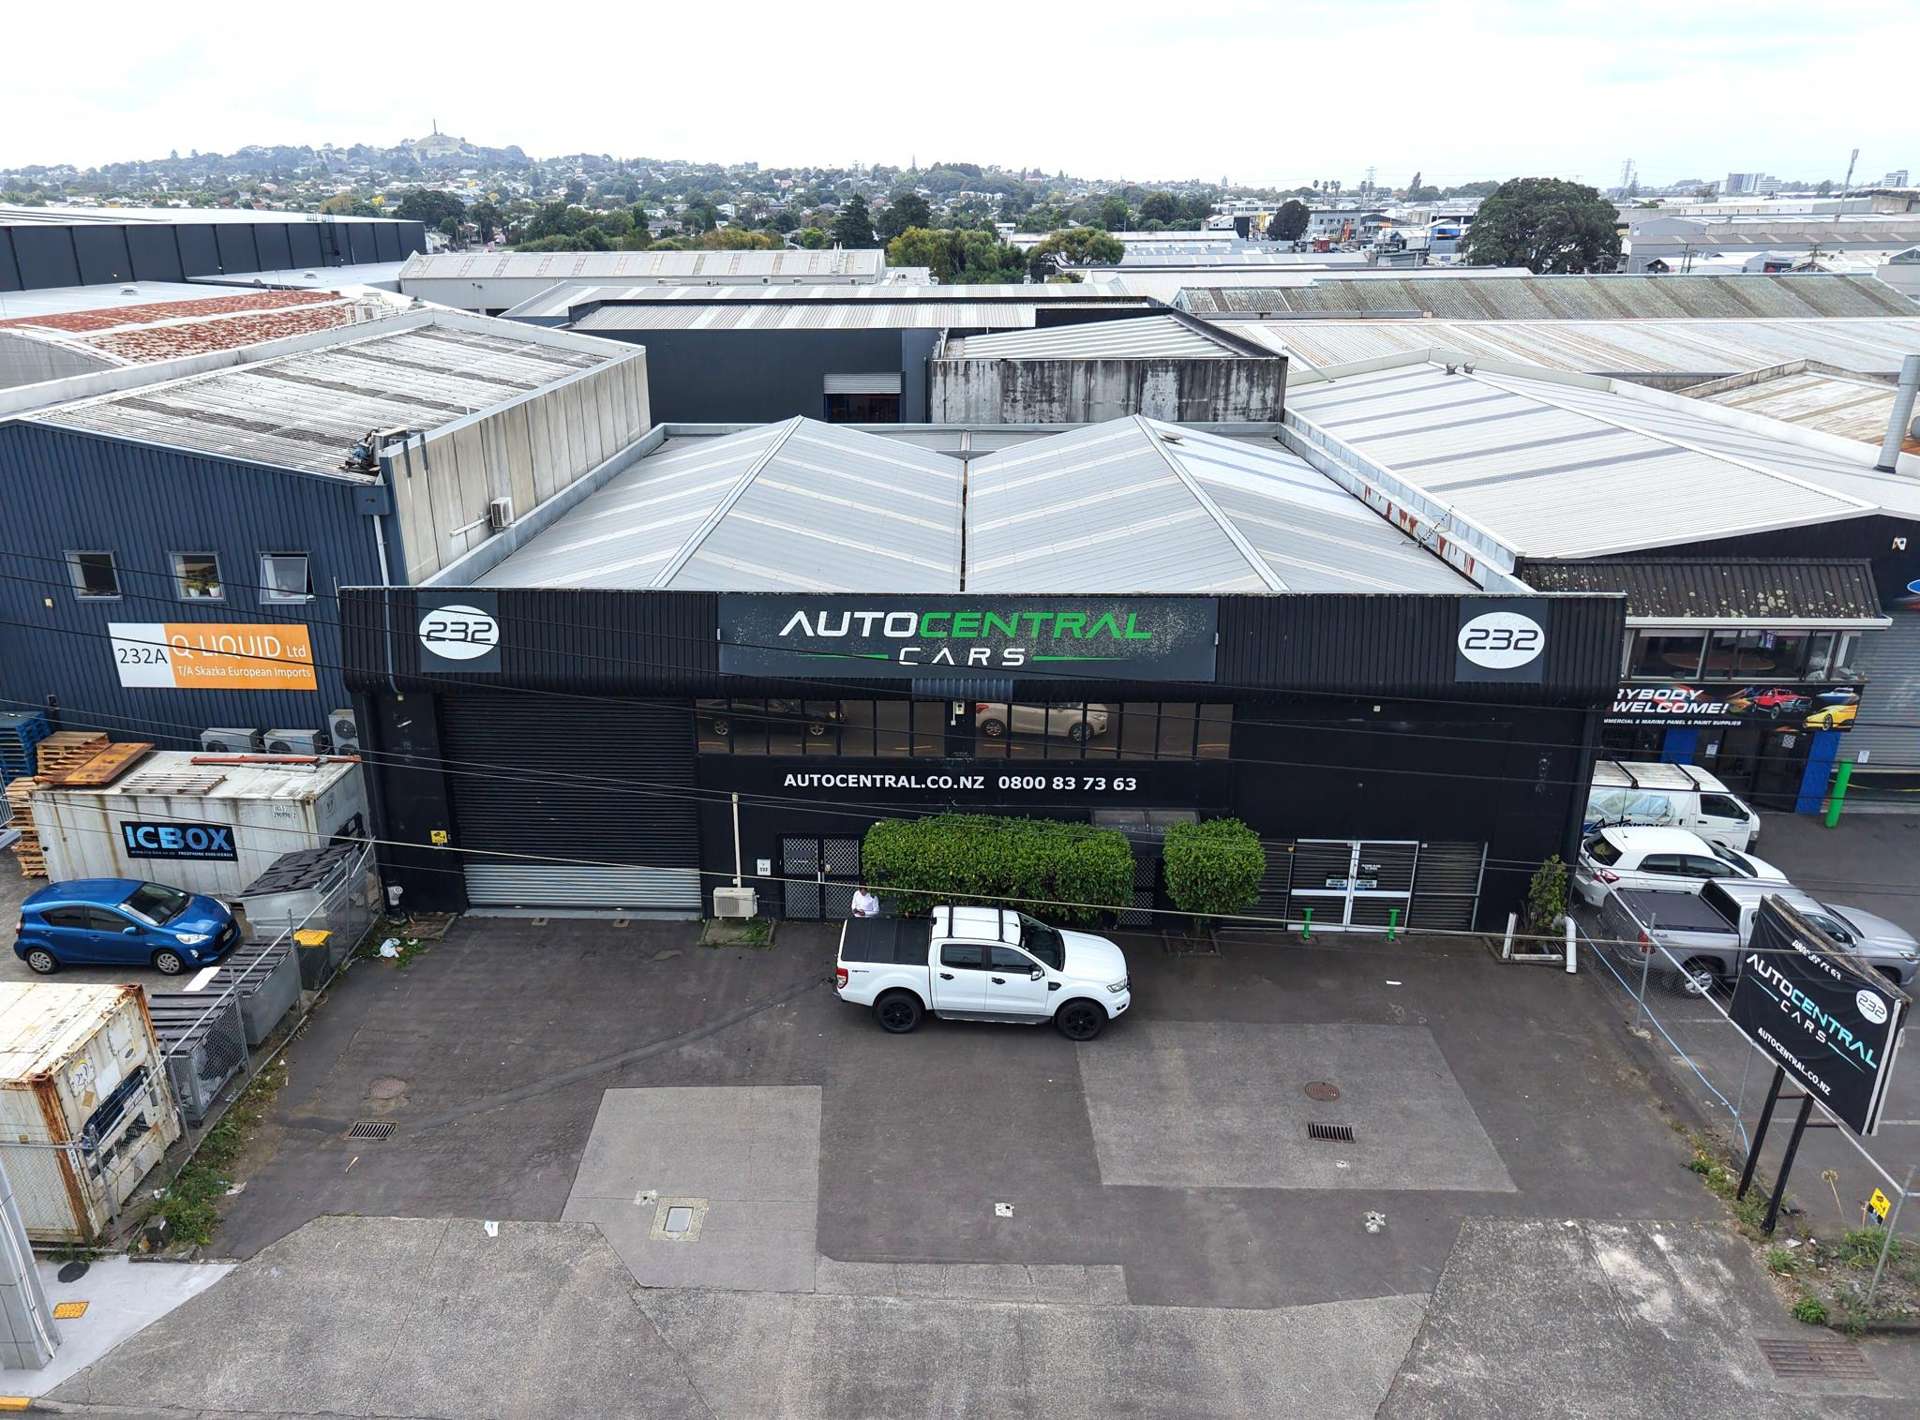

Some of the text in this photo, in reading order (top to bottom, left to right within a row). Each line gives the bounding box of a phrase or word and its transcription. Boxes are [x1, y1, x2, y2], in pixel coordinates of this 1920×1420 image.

[426, 621, 492, 642] 232
[779, 611, 1153, 639] AUTOCENTRAL
[1464, 628, 1539, 651] 232
[117, 648, 168, 664] 232A
[286, 644, 306, 658] Ltd
[899, 647, 1026, 667] CARS
[176, 666, 312, 679] T/A Skazka European Imports
[1612, 701, 1730, 715] WELCOME!
[784, 773, 1138, 791] AUTOCENTRAL.CO.NZ 0800 83 73 63
[1746, 953, 1878, 1070] AUTOCENTRAL
[1858, 994, 1886, 1020] 232
[1780, 999, 1828, 1045] CARS
[1757, 1027, 1832, 1096] AUTOCENTRAL.CO.NZ
